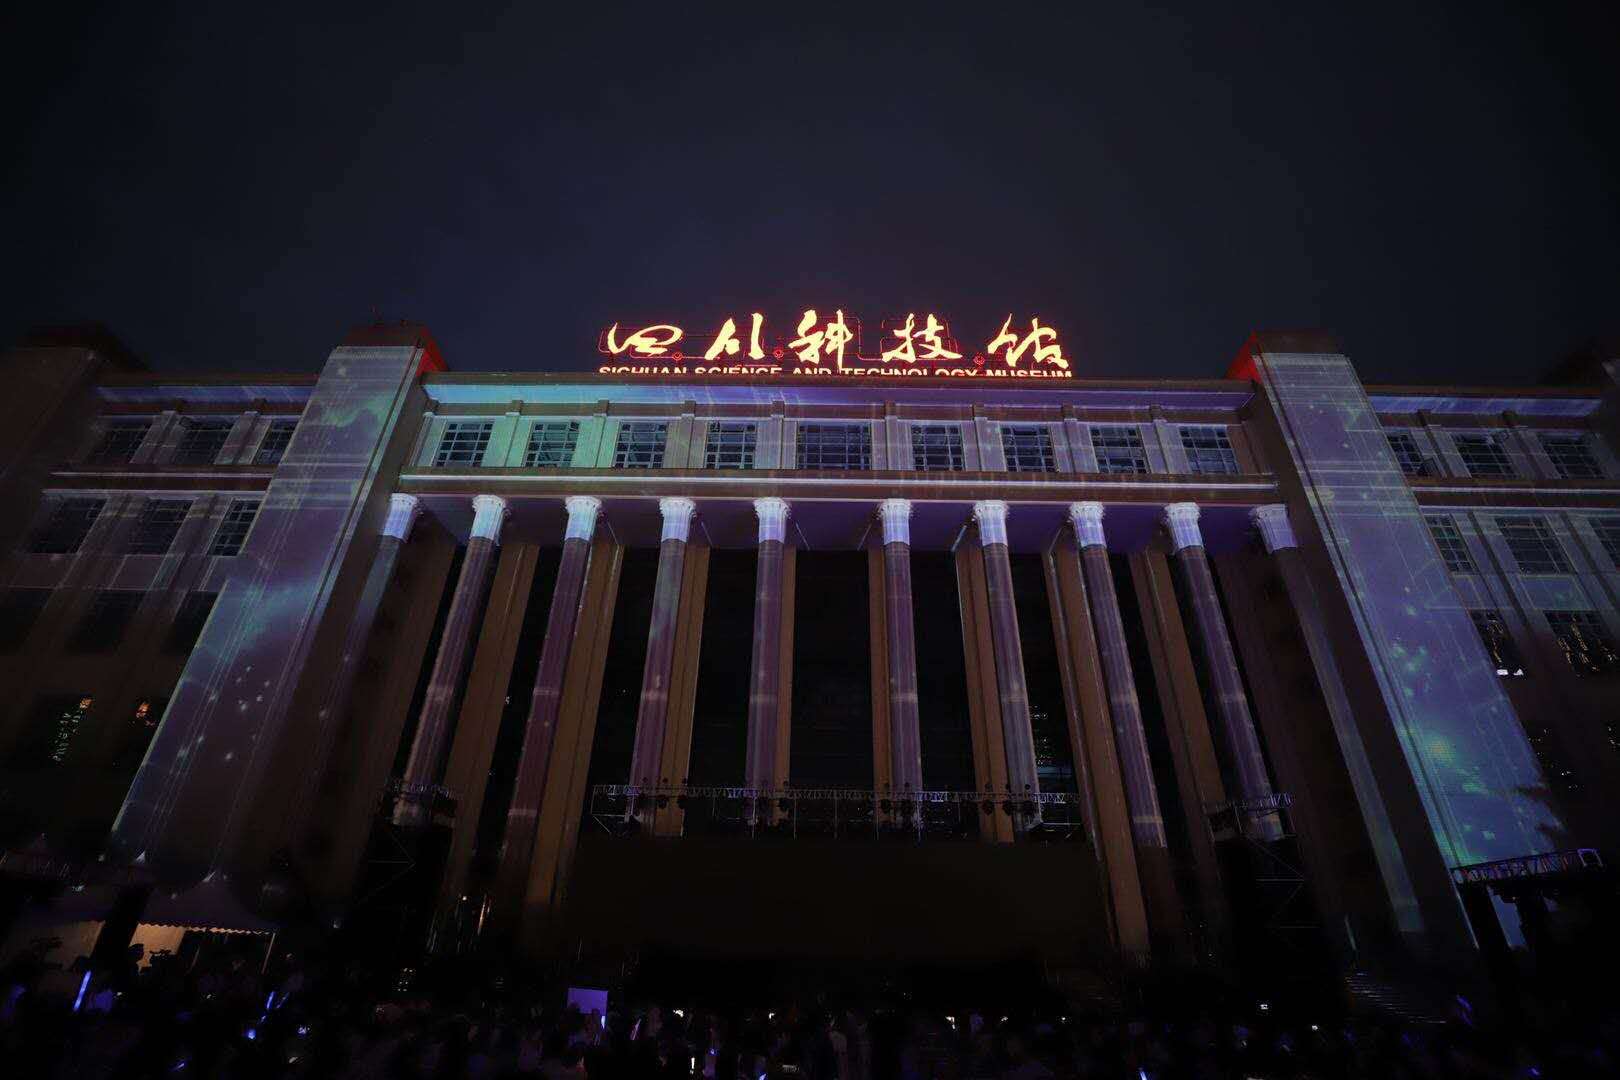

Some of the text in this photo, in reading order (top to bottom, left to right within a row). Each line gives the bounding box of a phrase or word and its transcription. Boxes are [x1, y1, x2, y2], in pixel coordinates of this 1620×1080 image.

[606, 309, 1068, 373] 四川科技馆
[599, 366, 688, 375] SICHUAN
[694, 366, 783, 375] SCIENCE
[793, 367, 832, 375] AND
